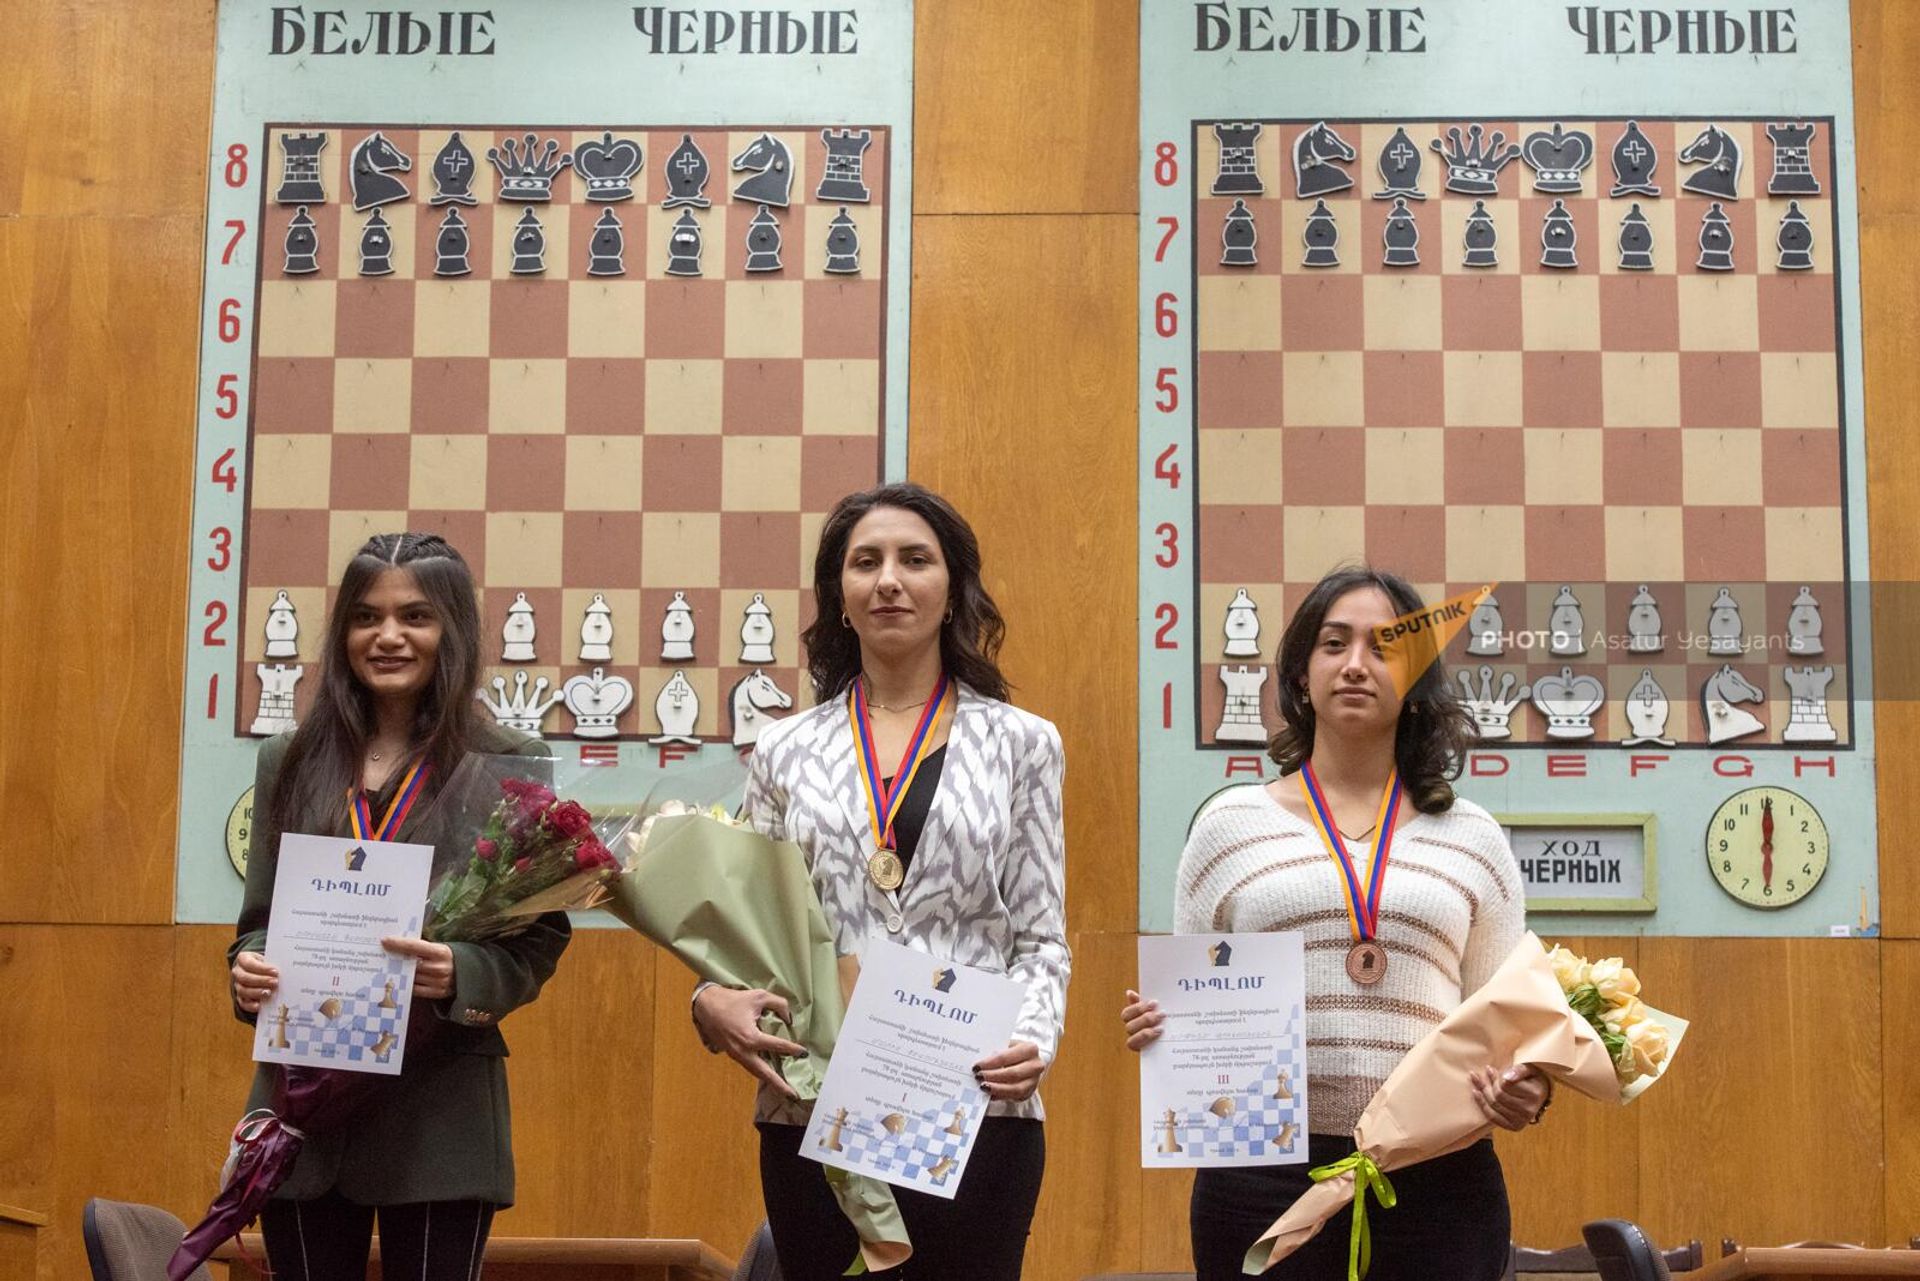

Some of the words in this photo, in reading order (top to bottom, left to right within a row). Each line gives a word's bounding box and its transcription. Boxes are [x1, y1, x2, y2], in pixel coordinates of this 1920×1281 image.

[269, 6, 496, 56] БЕЛЫЕ
[632, 7, 859, 55] ЧЕРНЫЕ
[1194, 2, 1427, 53] БЕЛЫЕ
[1567, 7, 1798, 54] ЧЕРНЫЕ
[225, 143, 248, 188] 8
[1154, 142, 1178, 186] 8
[222, 220, 246, 265] 7
[1155, 216, 1179, 262] 7
[218, 298, 241, 343] 6
[1155, 293, 1178, 338] 6
[216, 375, 238, 419] 5
[1155, 368, 1178, 413] 5
[211, 448, 237, 493] 4
[1155, 444, 1181, 488] 4
[208, 526, 232, 572] 3
[1155, 523, 1179, 568] 3
[203, 601, 228, 646] 2
[1154, 603, 1178, 649] 2
[207, 674, 219, 719] 1
[1163, 682, 1172, 729] 1
[580, 744, 617, 767] E
[659, 746, 698, 768] F
[1225, 756, 1264, 778] A
[1470, 755, 1509, 777] D
[1547, 755, 1587, 777] E
[1630, 755, 1670, 778] F
[1712, 755, 1753, 777] G
[1794, 756, 1835, 777] H
[1724, 819, 1736, 831] 10
[1740, 803, 1749, 816] 11
[1801, 820, 1809, 833] 2
[239, 828, 248, 841] 9
[1541, 840, 1601, 857] ХОД
[1719, 840, 1729, 852] 9
[1807, 841, 1816, 854] 3
[1520, 859, 1621, 883] ЧЕРНЫХ
[1723, 860, 1732, 872] 8
[1741, 878, 1750, 890] 7
[1786, 879, 1795, 892] 5
[1802, 863, 1811, 875] 4
[1763, 883, 1773, 896] 6
